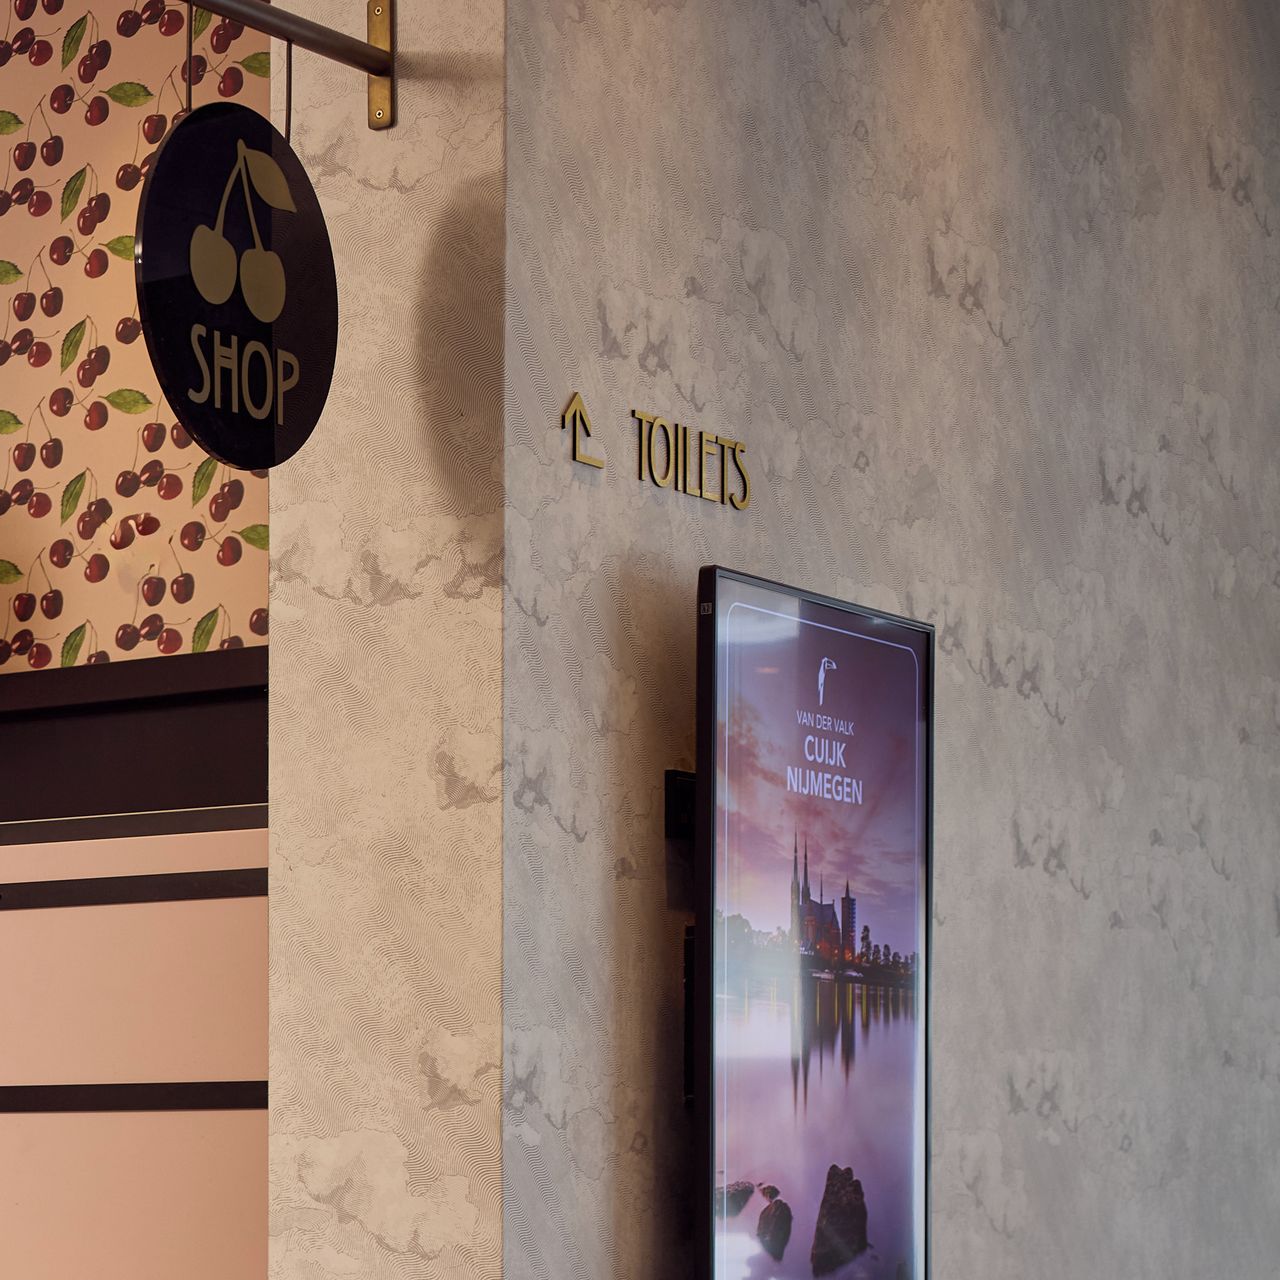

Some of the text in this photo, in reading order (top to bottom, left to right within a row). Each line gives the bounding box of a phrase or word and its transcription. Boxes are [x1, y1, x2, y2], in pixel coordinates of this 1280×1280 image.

[188, 323, 300, 425] SHOP
[632, 409, 751, 511] TOILETS
[796, 710, 854, 736] VAN DER VALK
[804, 735, 846, 768] CUIJK
[787, 766, 863, 804] NIJMEGEN
